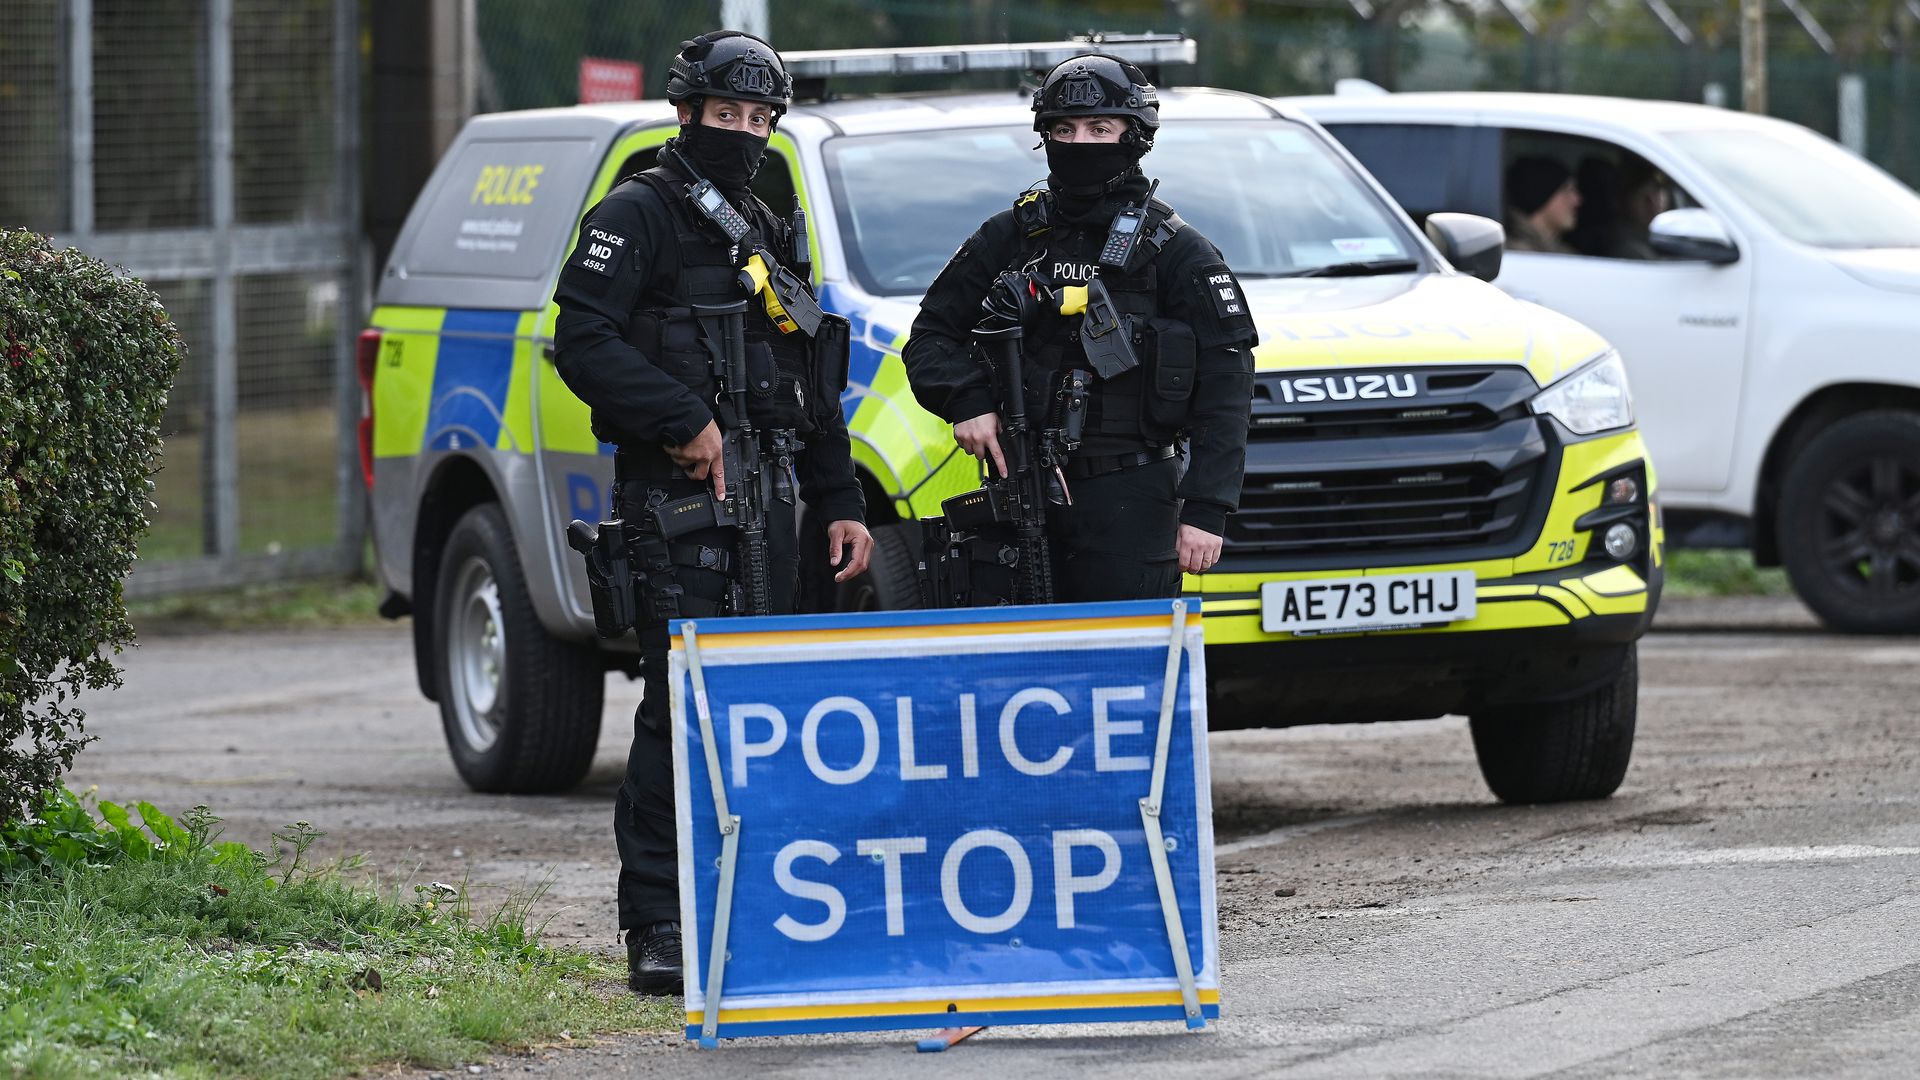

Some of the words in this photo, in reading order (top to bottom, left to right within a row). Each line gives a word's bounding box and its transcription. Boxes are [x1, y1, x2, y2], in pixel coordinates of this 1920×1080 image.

[469, 164, 544, 205] POLICE
[590, 229, 625, 246] POLICE
[588, 243, 612, 260] MD
[583, 259, 606, 272] 4582
[1053, 262, 1100, 281] POLICE
[1219, 288, 1235, 301] MD
[1279, 373, 1418, 403] ISUZU
[1549, 539, 1575, 563] 728
[1281, 583, 1376, 623] AE73
[1388, 577, 1459, 616] CHJ
[728, 683, 1151, 788] POLICE
[773, 829, 1122, 941] STOP
